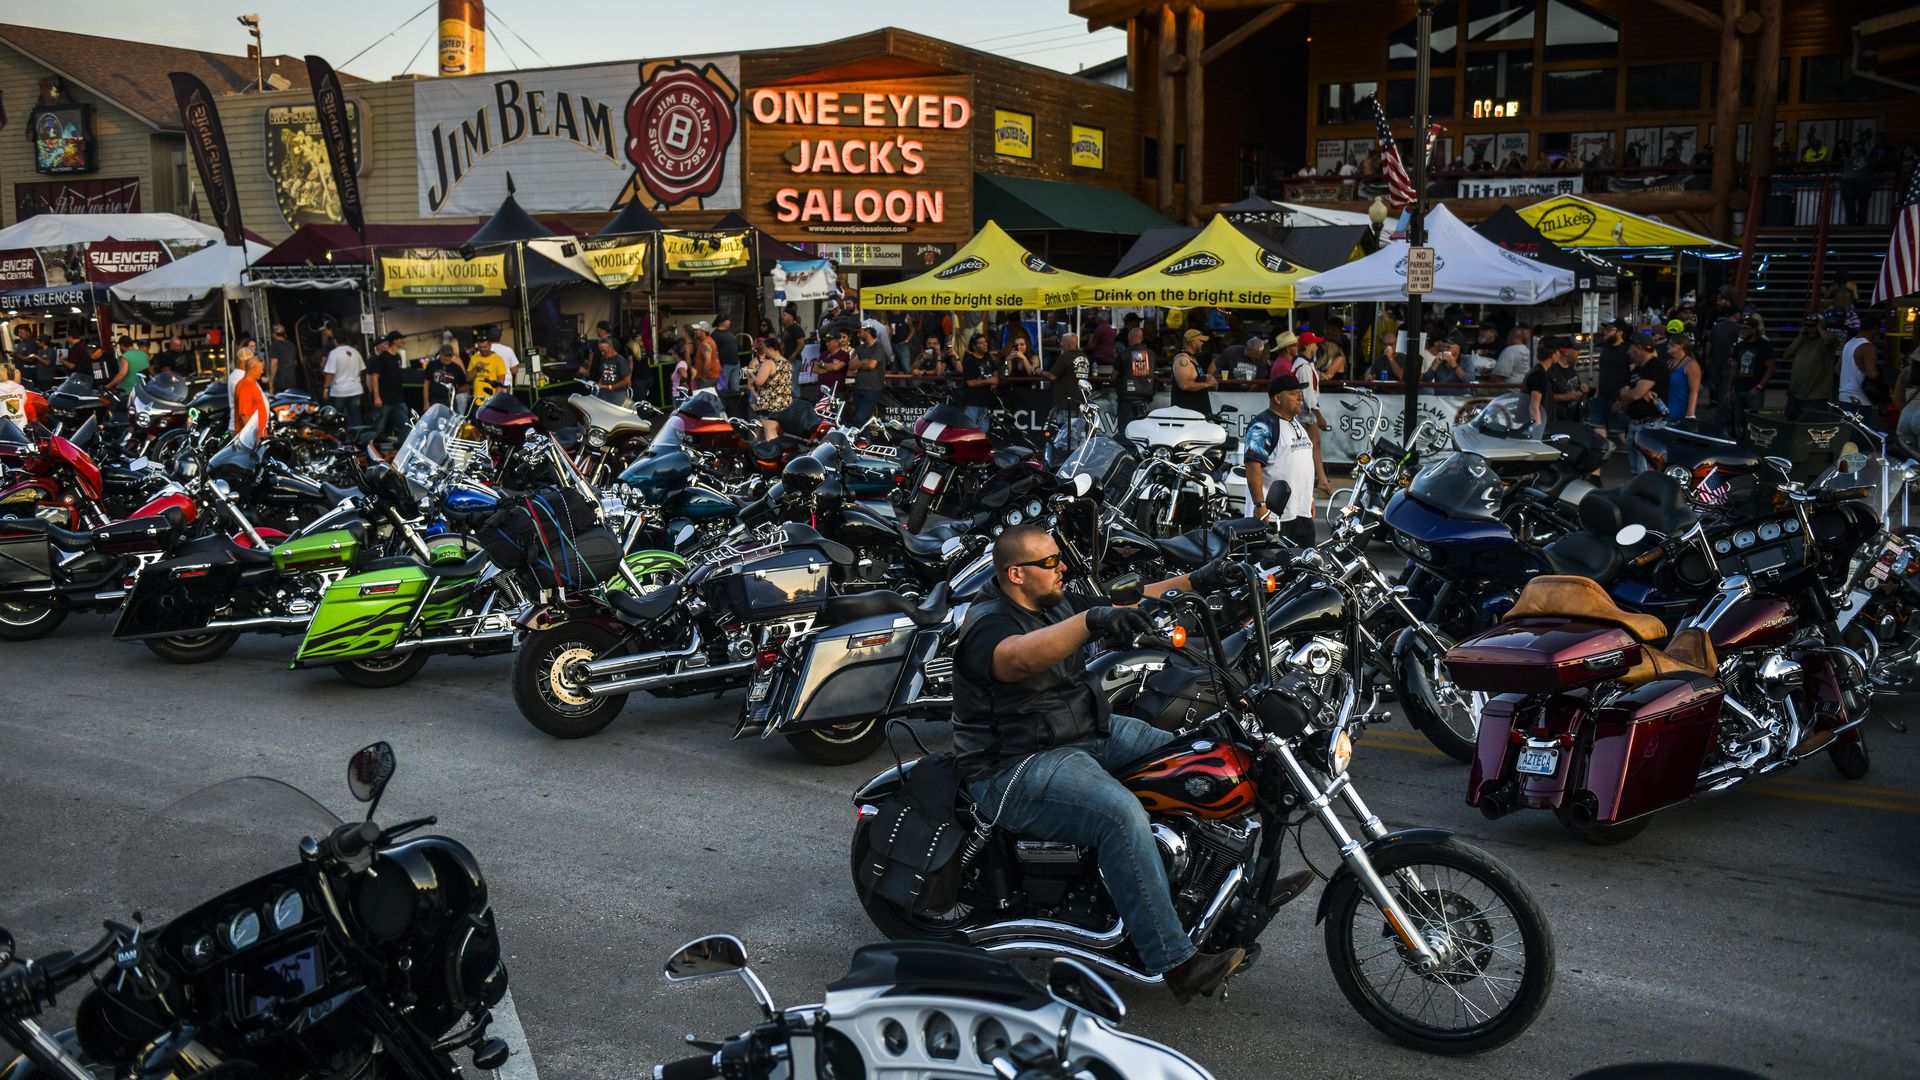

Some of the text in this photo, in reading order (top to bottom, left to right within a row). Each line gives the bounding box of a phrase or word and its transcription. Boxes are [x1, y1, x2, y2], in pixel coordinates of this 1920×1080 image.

[656, 92, 712, 133] JIM BEAM
[752, 89, 972, 129] ONE-EYED
[665, 112, 694, 151] B
[996, 126, 1029, 147] TWISTED TEA
[428, 78, 620, 214] JIM BEAM
[648, 128, 707, 173] SINCE 1795
[791, 134, 926, 175] JACK'S
[1072, 140, 1100, 159] TWISTED TEA
[1509, 184, 1555, 196] WELCOME
[775, 188, 944, 224] SALOON
[808, 224, 907, 233] www.oneeyedjackssaloon.com
[1542, 212, 1591, 233] mike's
[90, 251, 159, 264] SILENCER
[593, 252, 640, 269] NOODLES
[1169, 255, 1218, 272] mike's
[6, 270, 34, 280] CENTRAL
[118, 263, 158, 273] CENTRAL
[388, 263, 498, 279] ISLAND NOODLES
[941, 260, 983, 277] mike's
[1, 291, 85, 309] BUY A SILENCER
[875, 293, 1023, 308] Drink on the bright side
[1045, 292, 1060, 305] Drink
[1061, 294, 1070, 303] on
[1094, 289, 1271, 305] Drink on the bright side
[901, 407, 927, 415] PUREST
[1522, 753, 1551, 767] AZTECA
